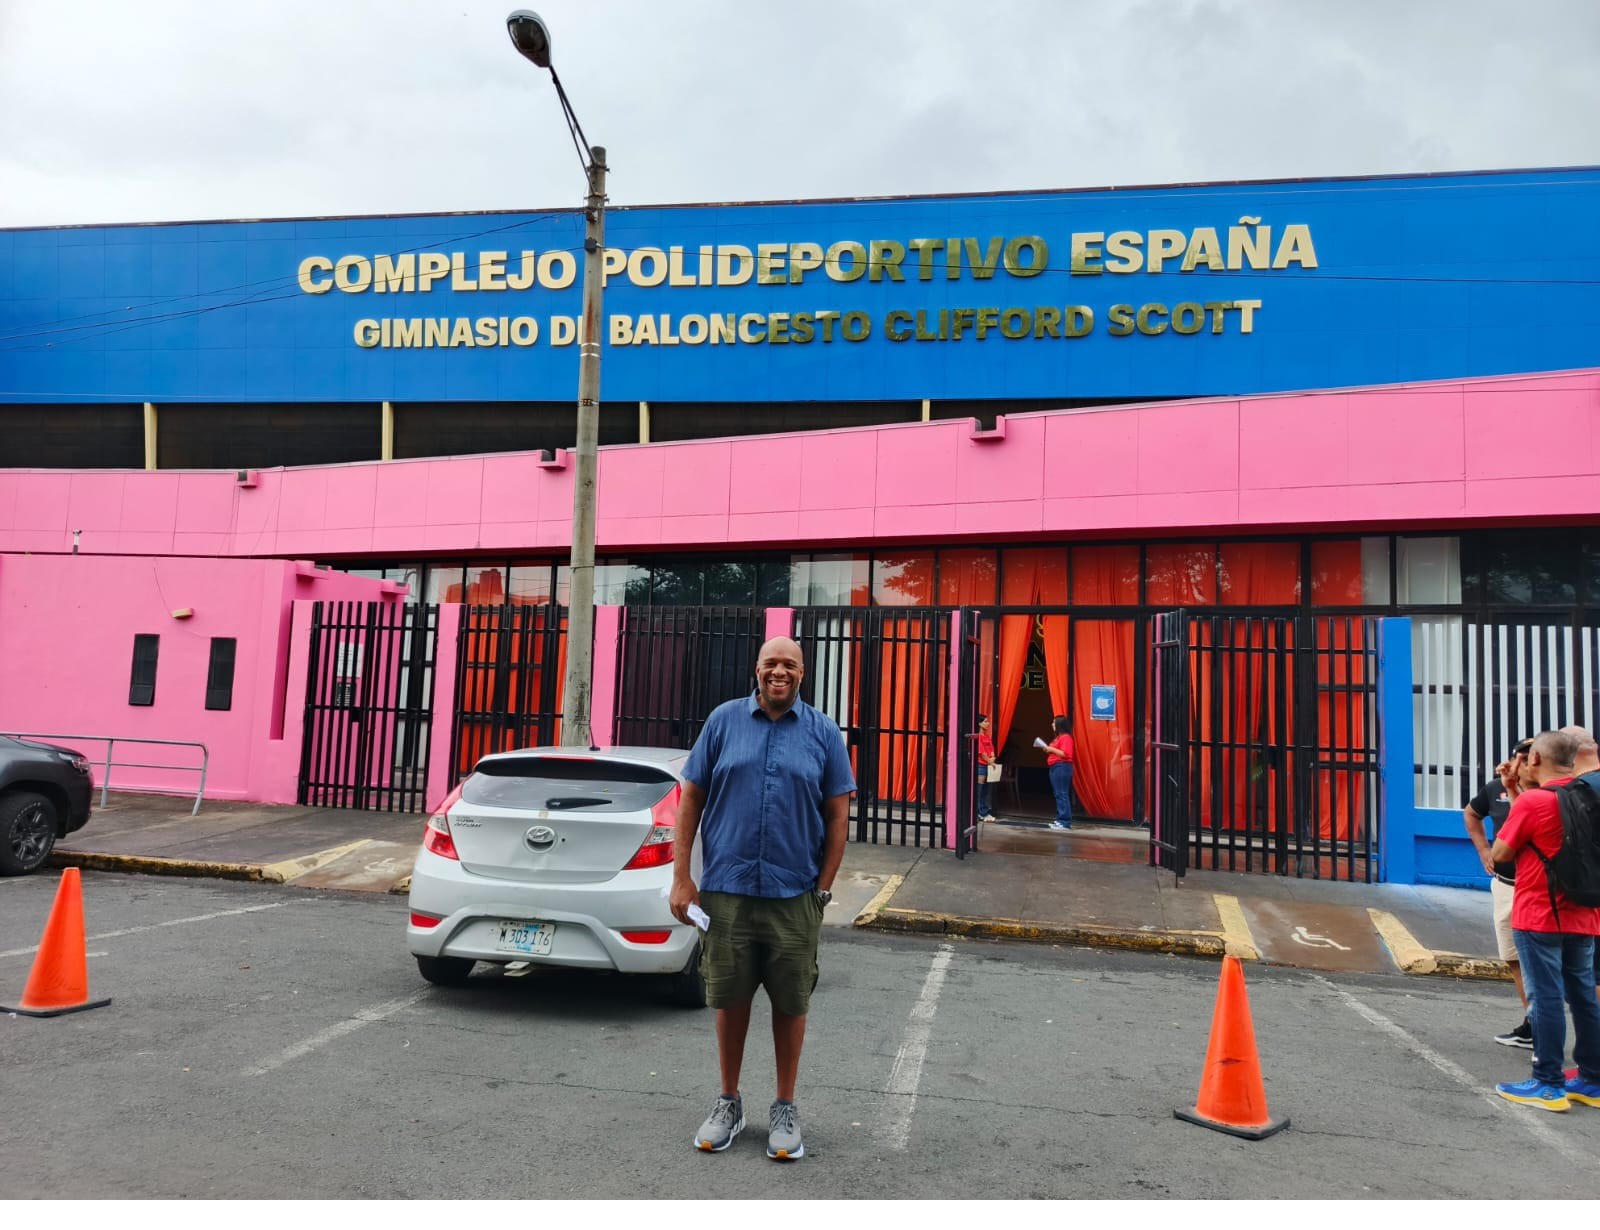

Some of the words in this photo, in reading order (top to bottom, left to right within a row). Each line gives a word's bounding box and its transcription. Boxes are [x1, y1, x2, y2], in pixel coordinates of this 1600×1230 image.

[297, 249, 577, 294] COMPLEJO
[602, 235, 1048, 288] POLIDEPORTIVO
[1071, 216, 1318, 275] ESPAÑA
[353, 316, 538, 348] GIMNASIO
[549, 315, 583, 346] D
[609, 310, 872, 345] BALONCESTO
[884, 304, 1094, 342] CLIFFORD
[1108, 299, 1262, 337] SCOTT
[508, 929, 529, 945] 303
[530, 931, 552, 946] 176
